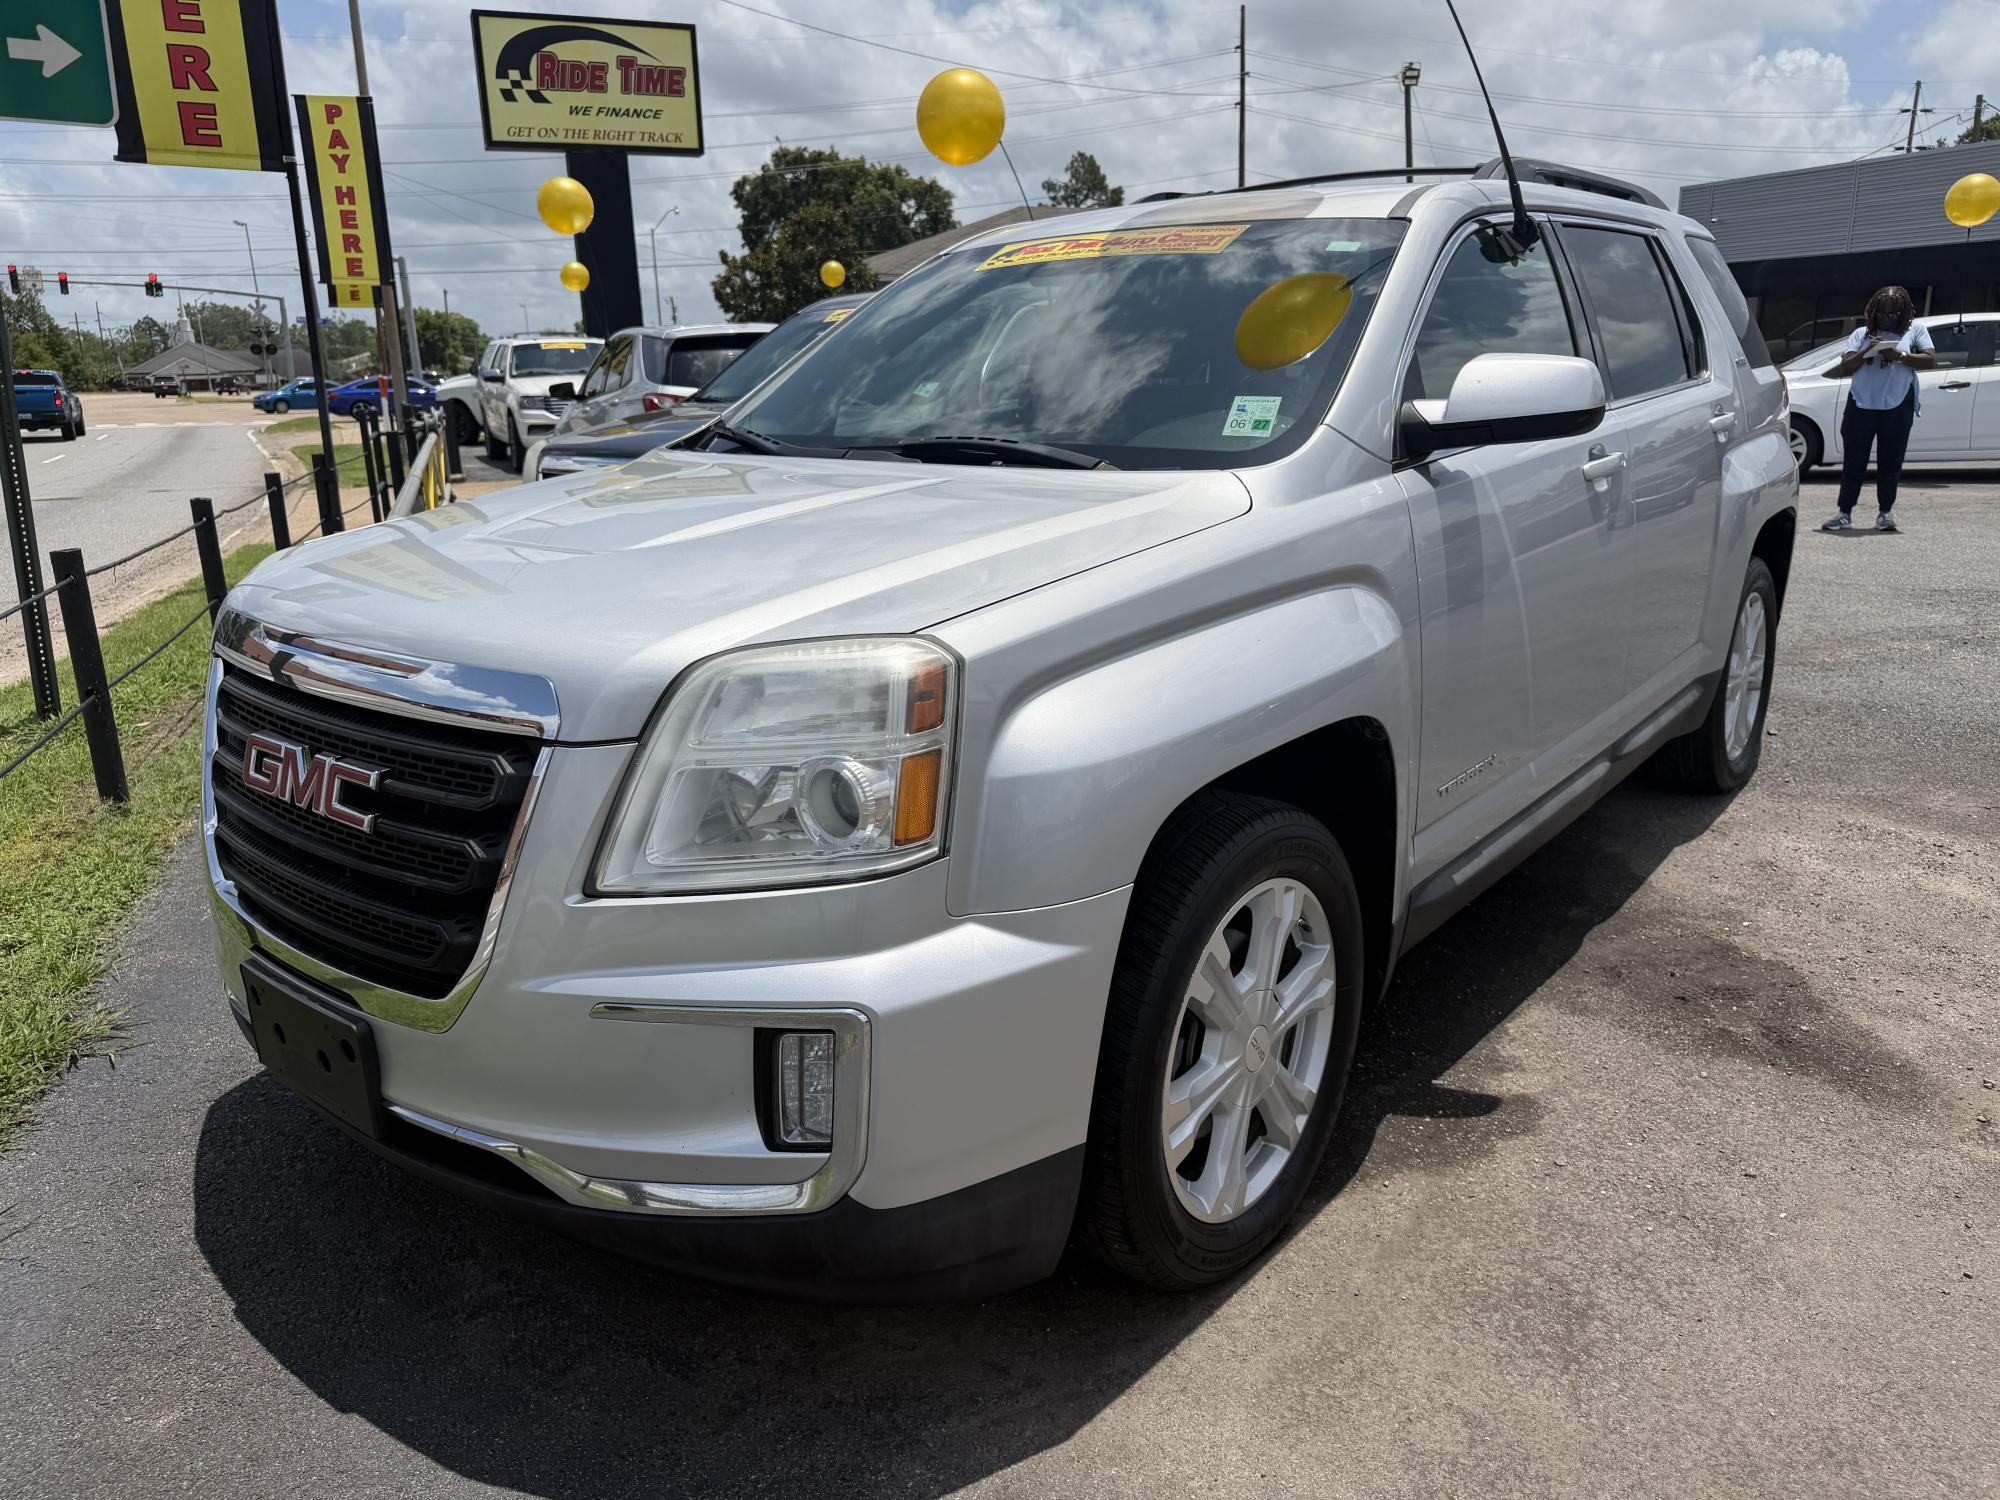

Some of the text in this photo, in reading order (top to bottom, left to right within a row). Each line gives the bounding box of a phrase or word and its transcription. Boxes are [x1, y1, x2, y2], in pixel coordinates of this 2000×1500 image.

[537, 51, 686, 97] RIDE TIME
[507, 126, 683, 143] GET ON THE RIGHT TRACK
[569, 105, 664, 119] WE FINANCE
[324, 103, 353, 175] PAY
[335, 185, 365, 278] HERE
[1230, 419, 1270, 430] 06 27
[243, 731, 382, 834] GMC
